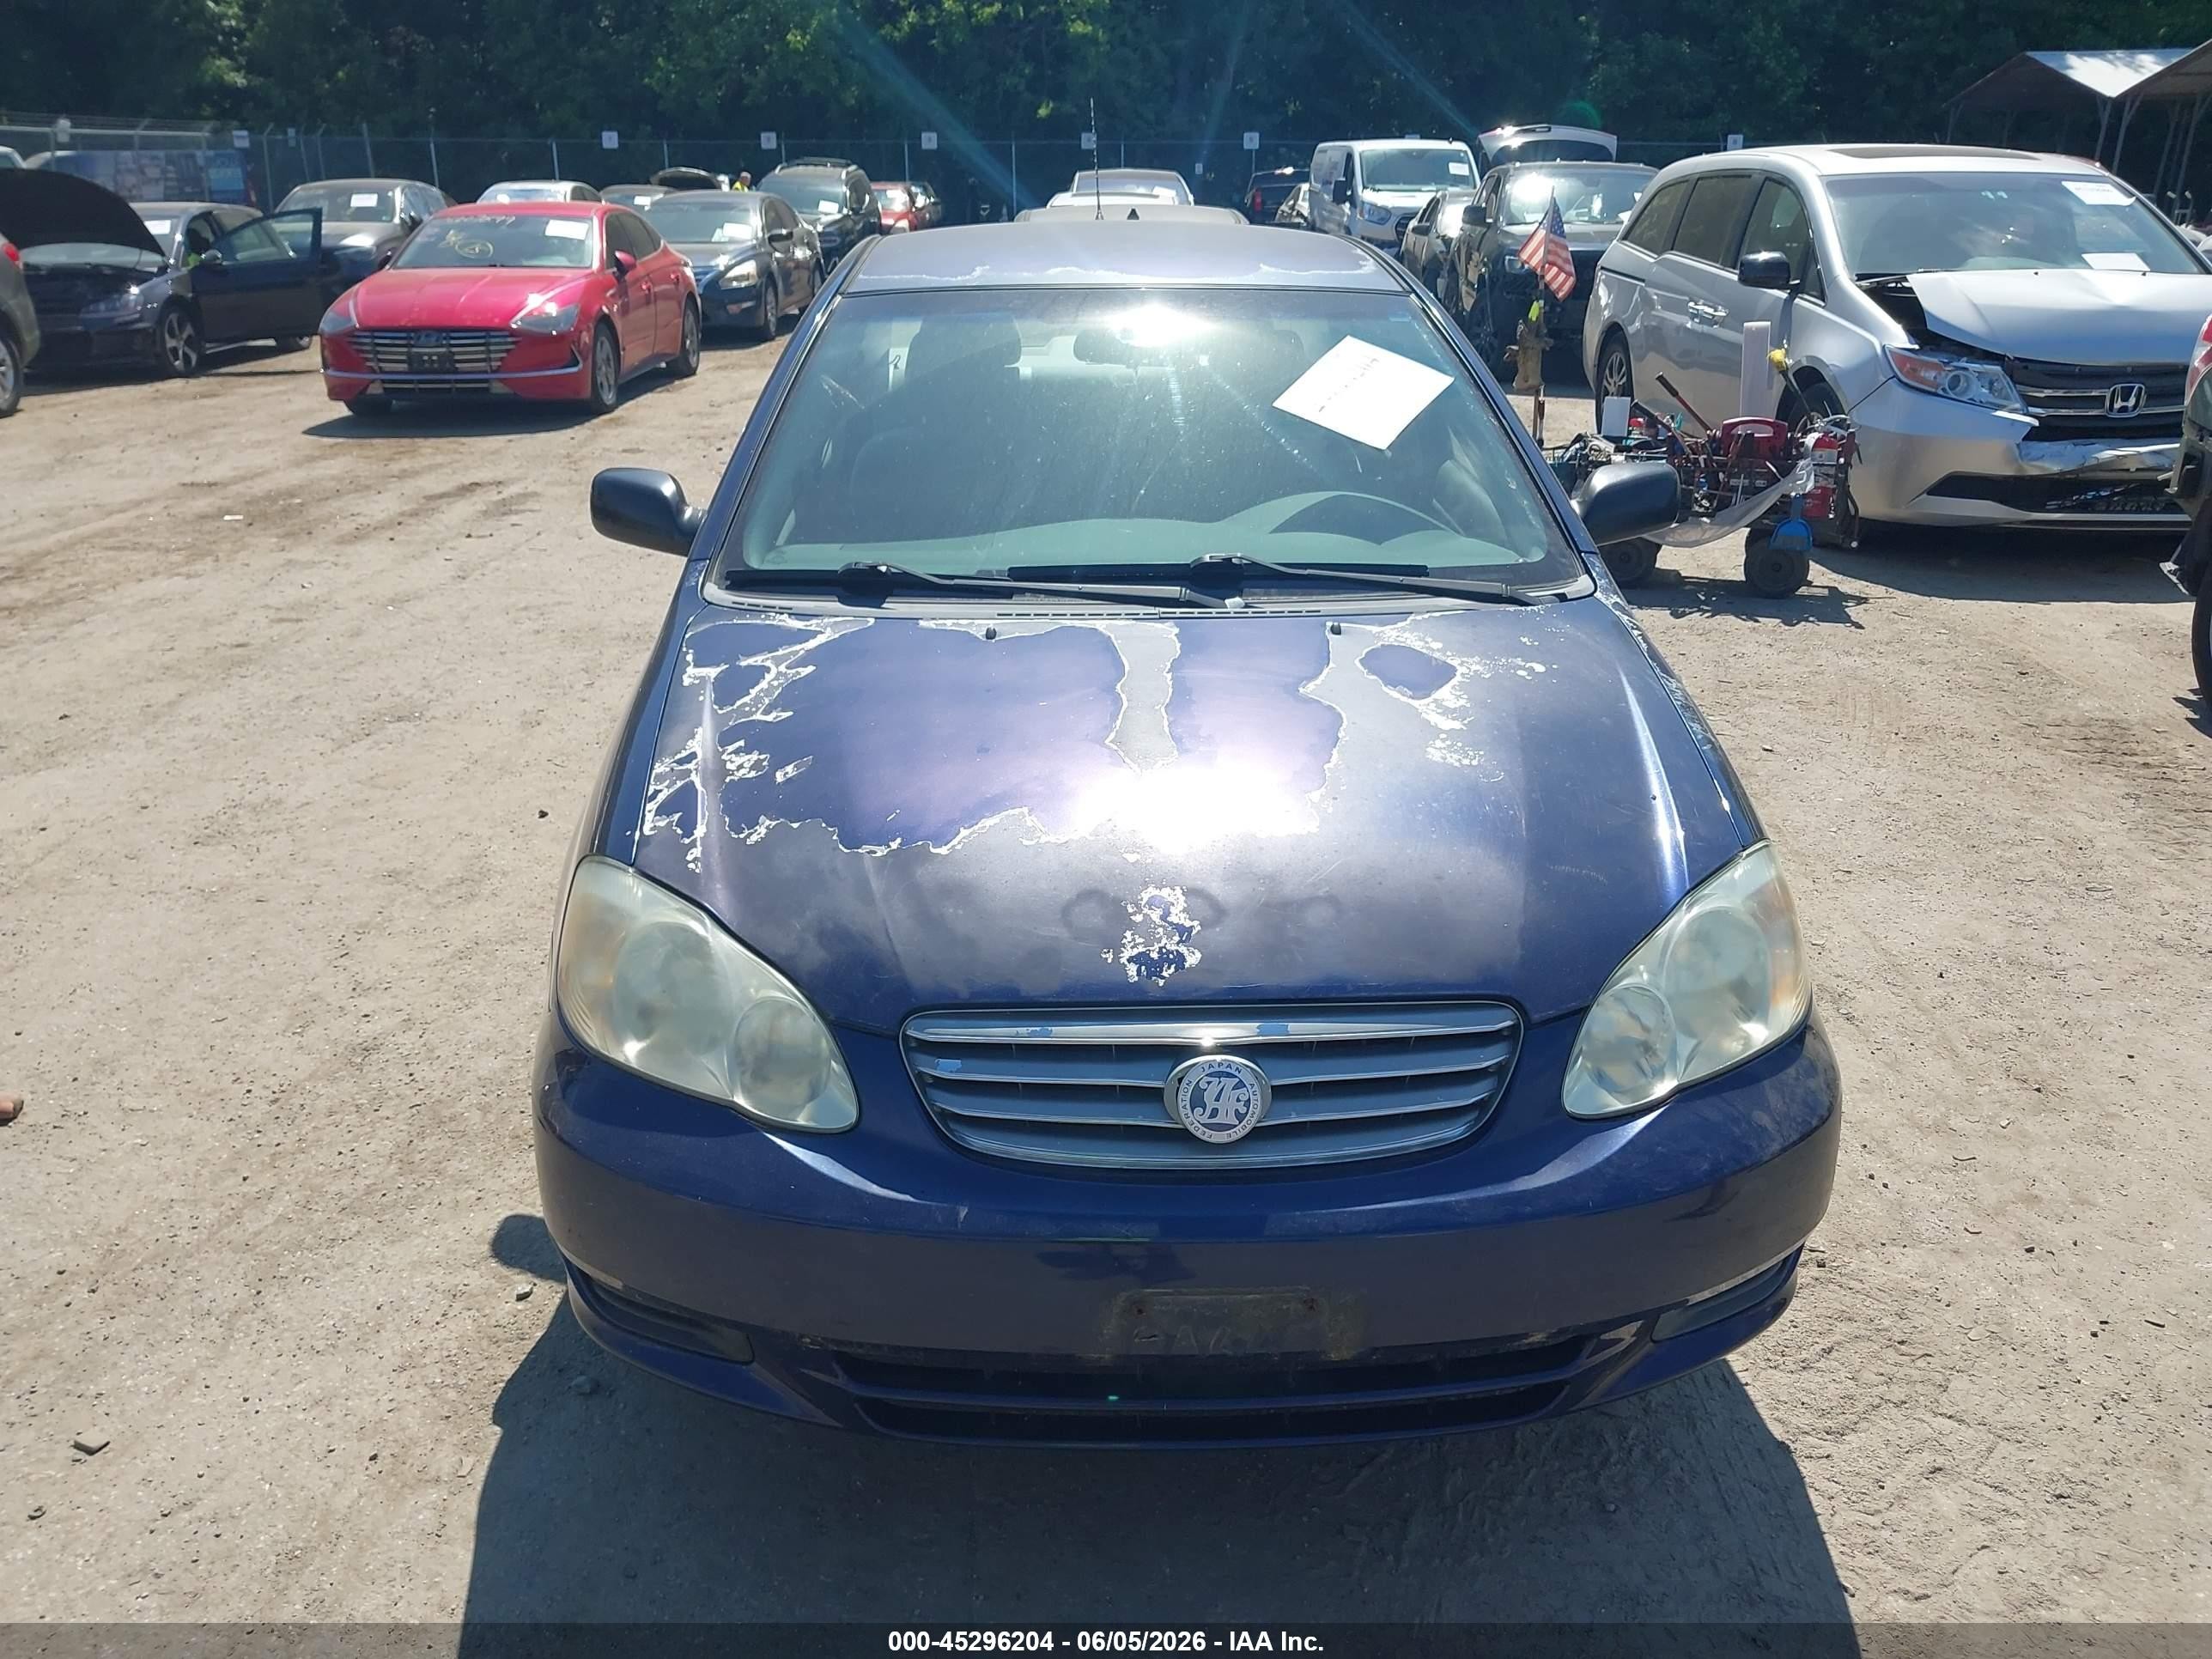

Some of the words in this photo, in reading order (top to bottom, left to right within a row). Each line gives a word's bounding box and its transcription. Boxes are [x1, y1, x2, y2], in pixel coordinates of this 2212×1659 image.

[1200, 1061, 1243, 1074] JAPAN
[1181, 1079, 1213, 1139] FEDERATION
[1225, 1082, 1260, 1139] AUTOMOBILE
